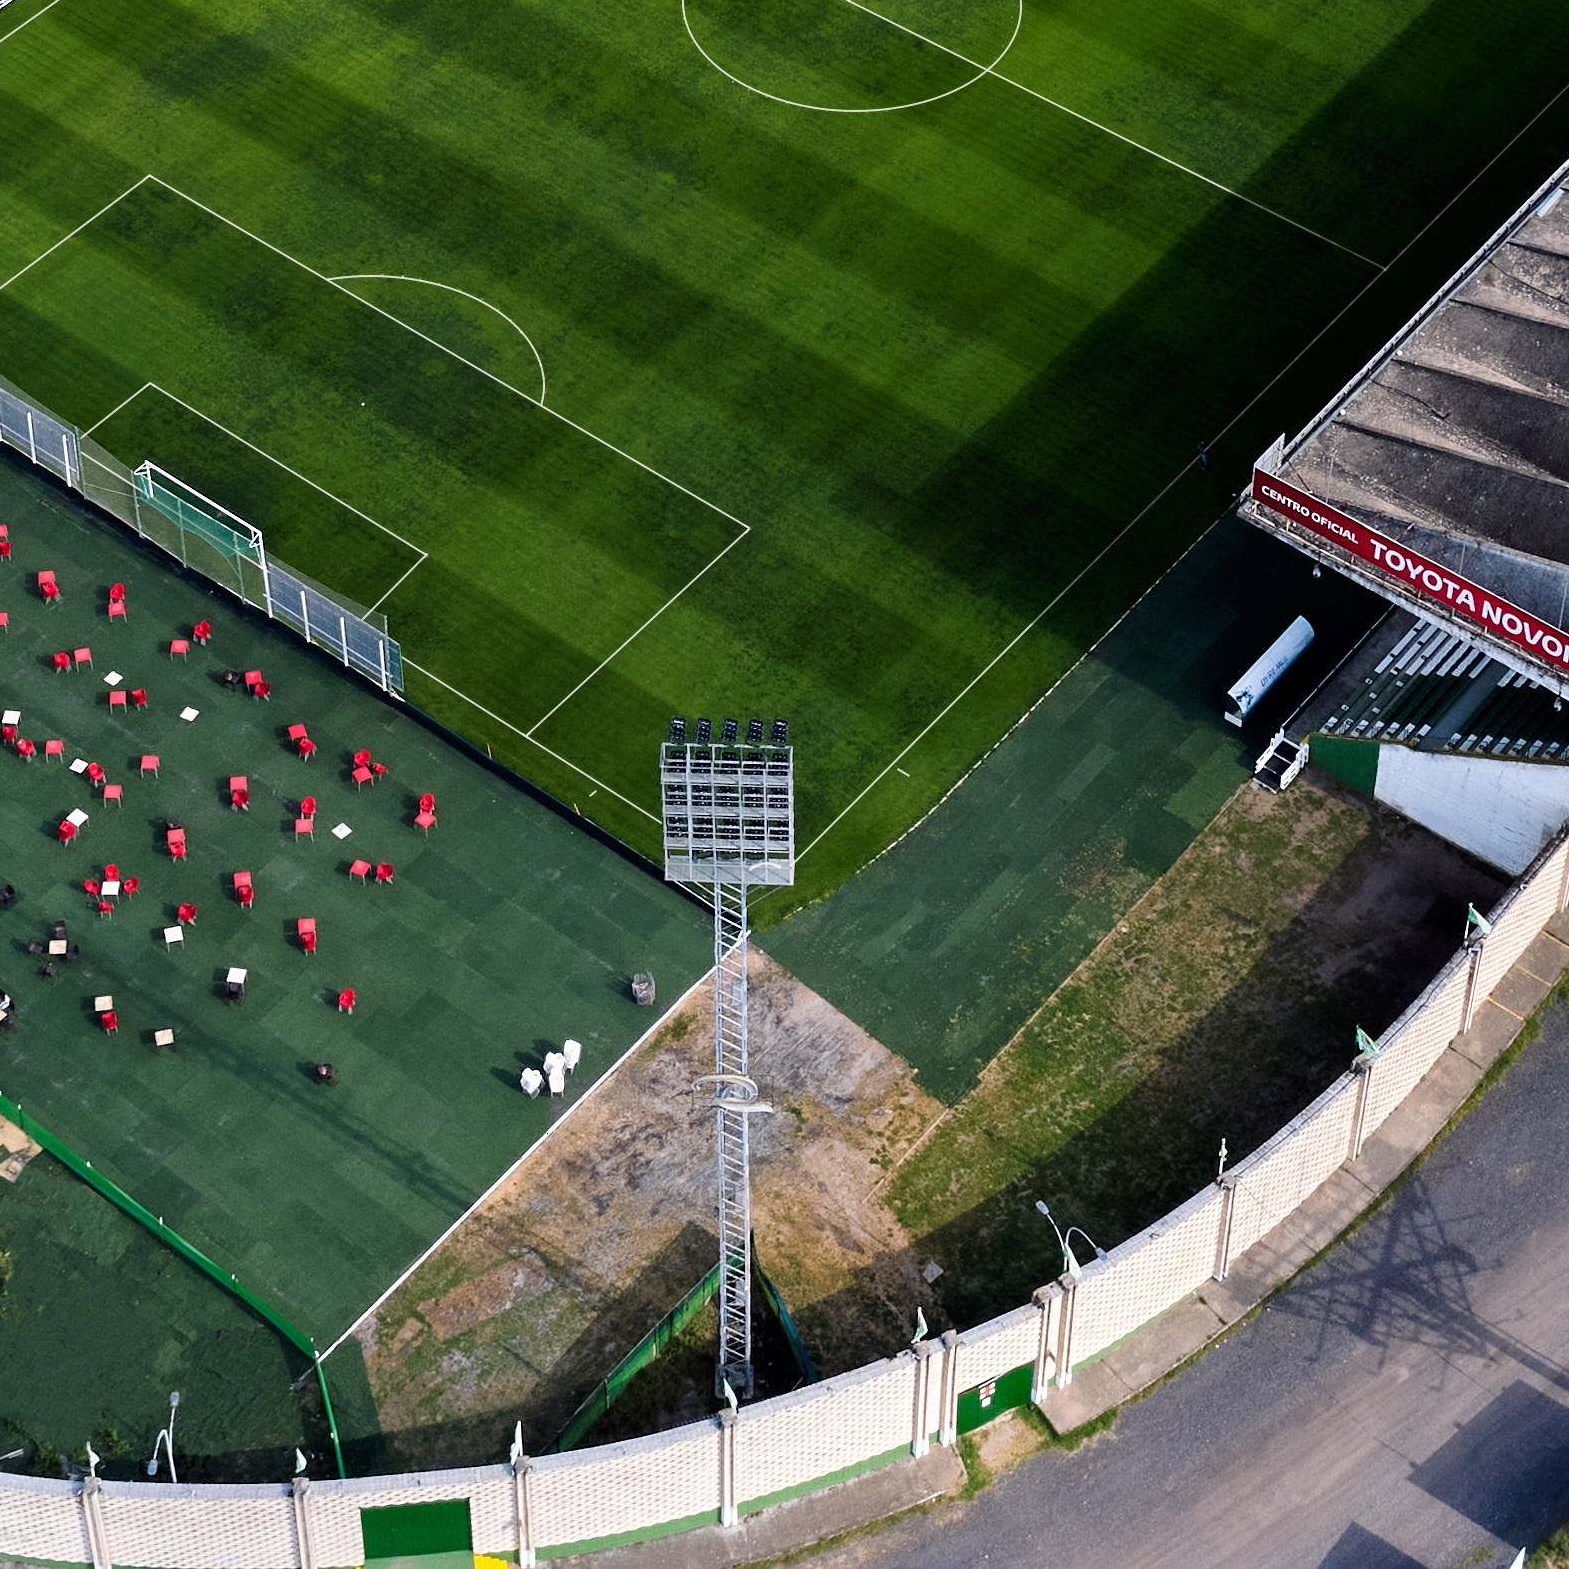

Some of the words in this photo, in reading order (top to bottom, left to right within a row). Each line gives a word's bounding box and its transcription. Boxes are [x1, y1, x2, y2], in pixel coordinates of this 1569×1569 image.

[1261, 485, 1311, 517] CENTRO
[1311, 512, 1359, 544] OFICIAL
[1369, 539, 1476, 612] TOYOTA
